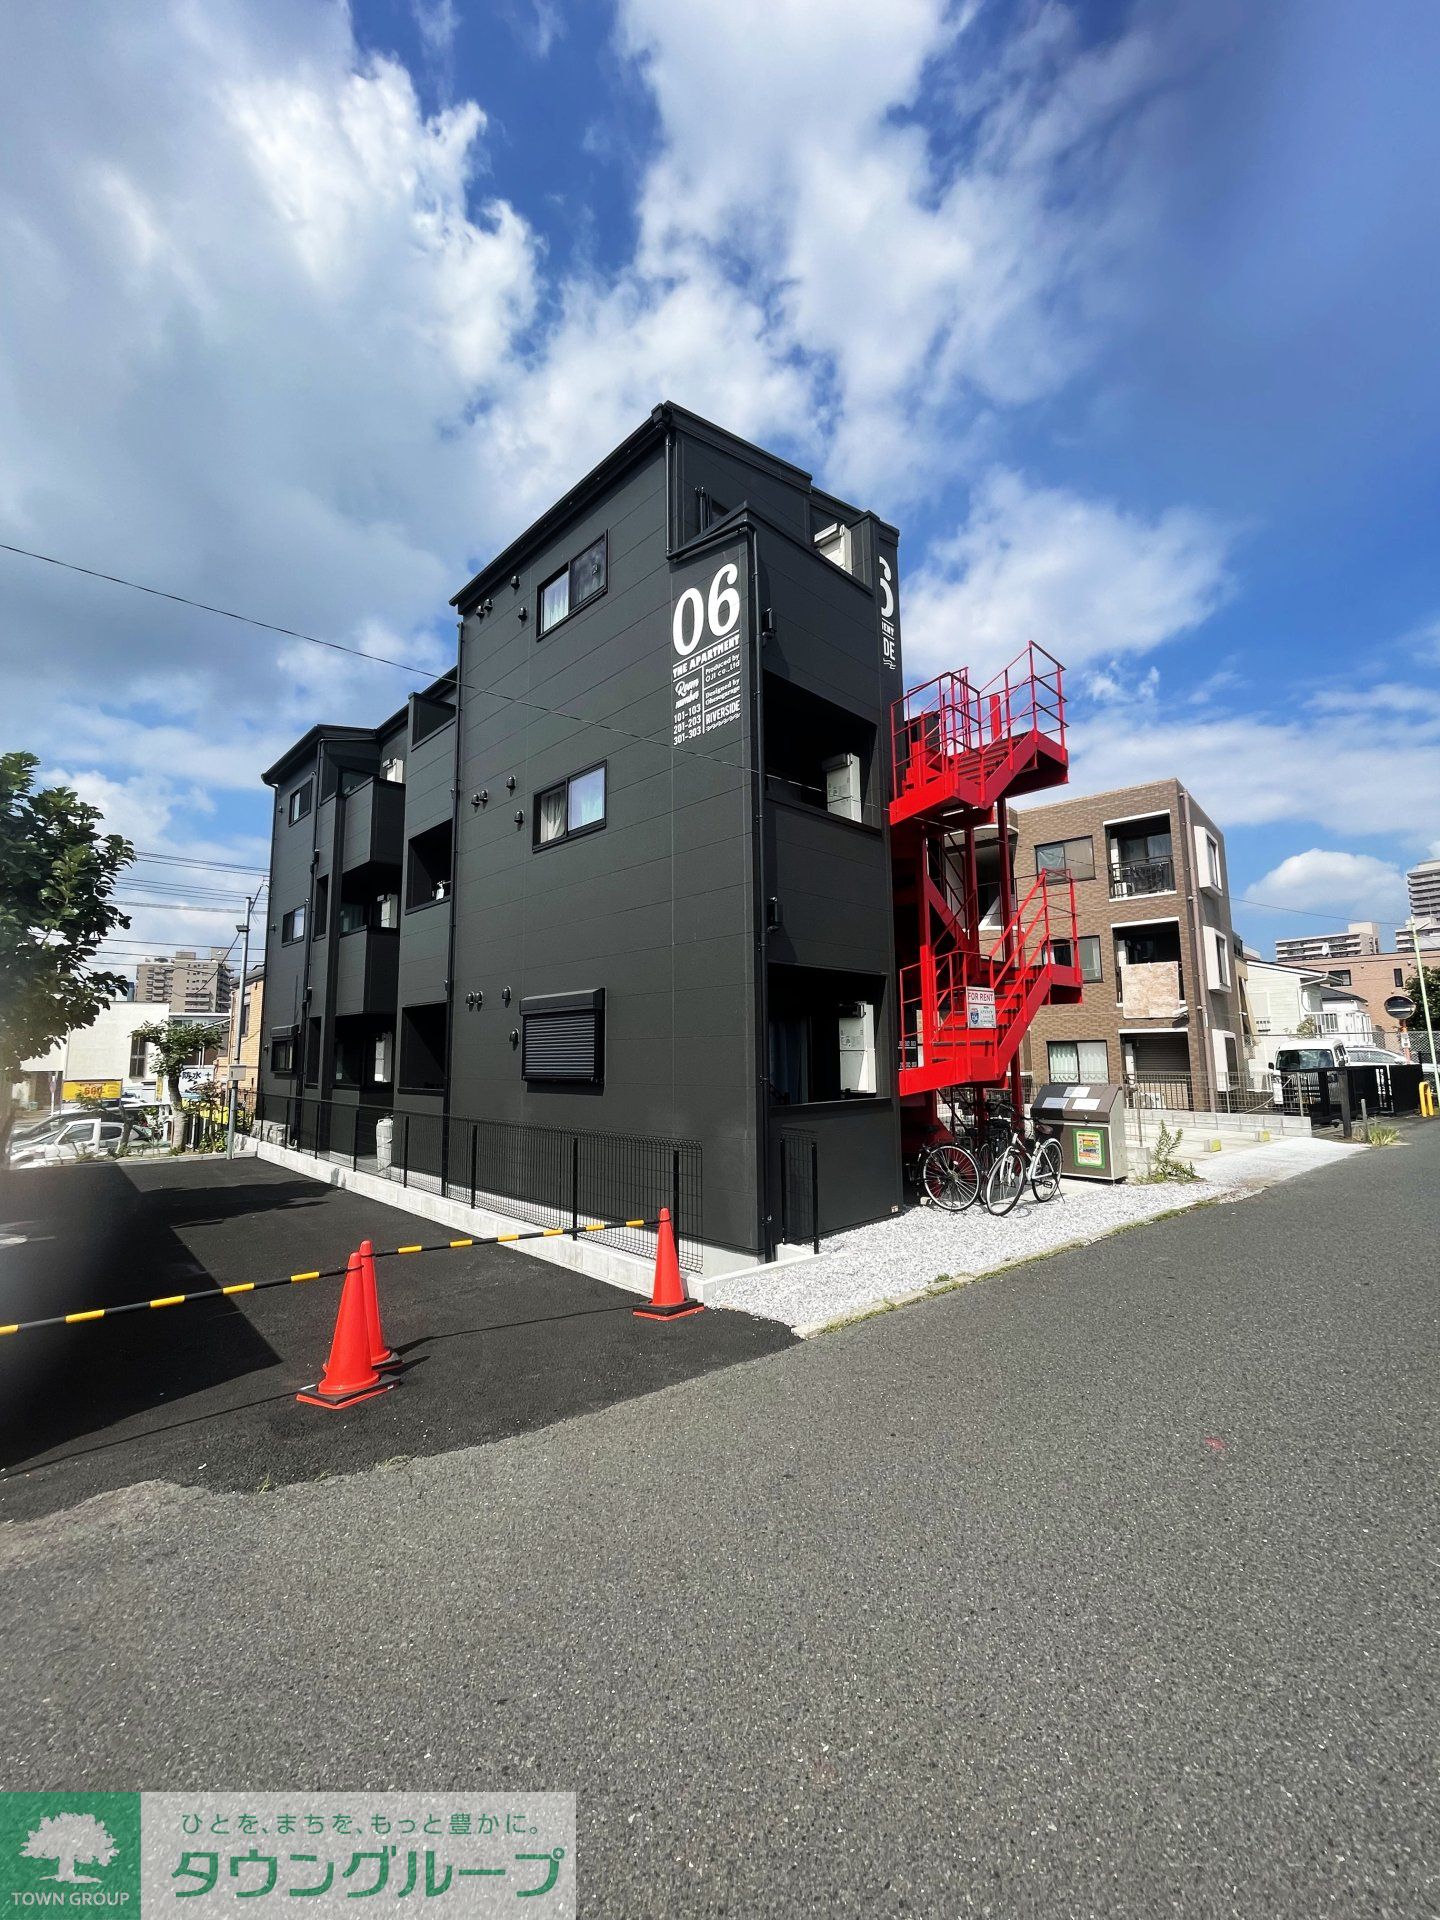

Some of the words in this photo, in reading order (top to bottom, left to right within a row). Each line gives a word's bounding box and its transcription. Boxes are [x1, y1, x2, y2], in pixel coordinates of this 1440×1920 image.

[672, 563, 740, 656] 06
[673, 662, 688, 679] THE
[689, 633, 740, 669] APARTMENT
[731, 653, 740, 662] by
[705, 681, 732, 700] Designed
[732, 678, 740, 687] by
[674, 703, 701, 724] 101-103
[705, 699, 740, 725] RIVERSIDE
[673, 714, 701, 735] 201-203
[673, 725, 701, 746] 301-303
[968, 992, 979, 1001] FOR
[980, 993, 994, 1002] RENT
